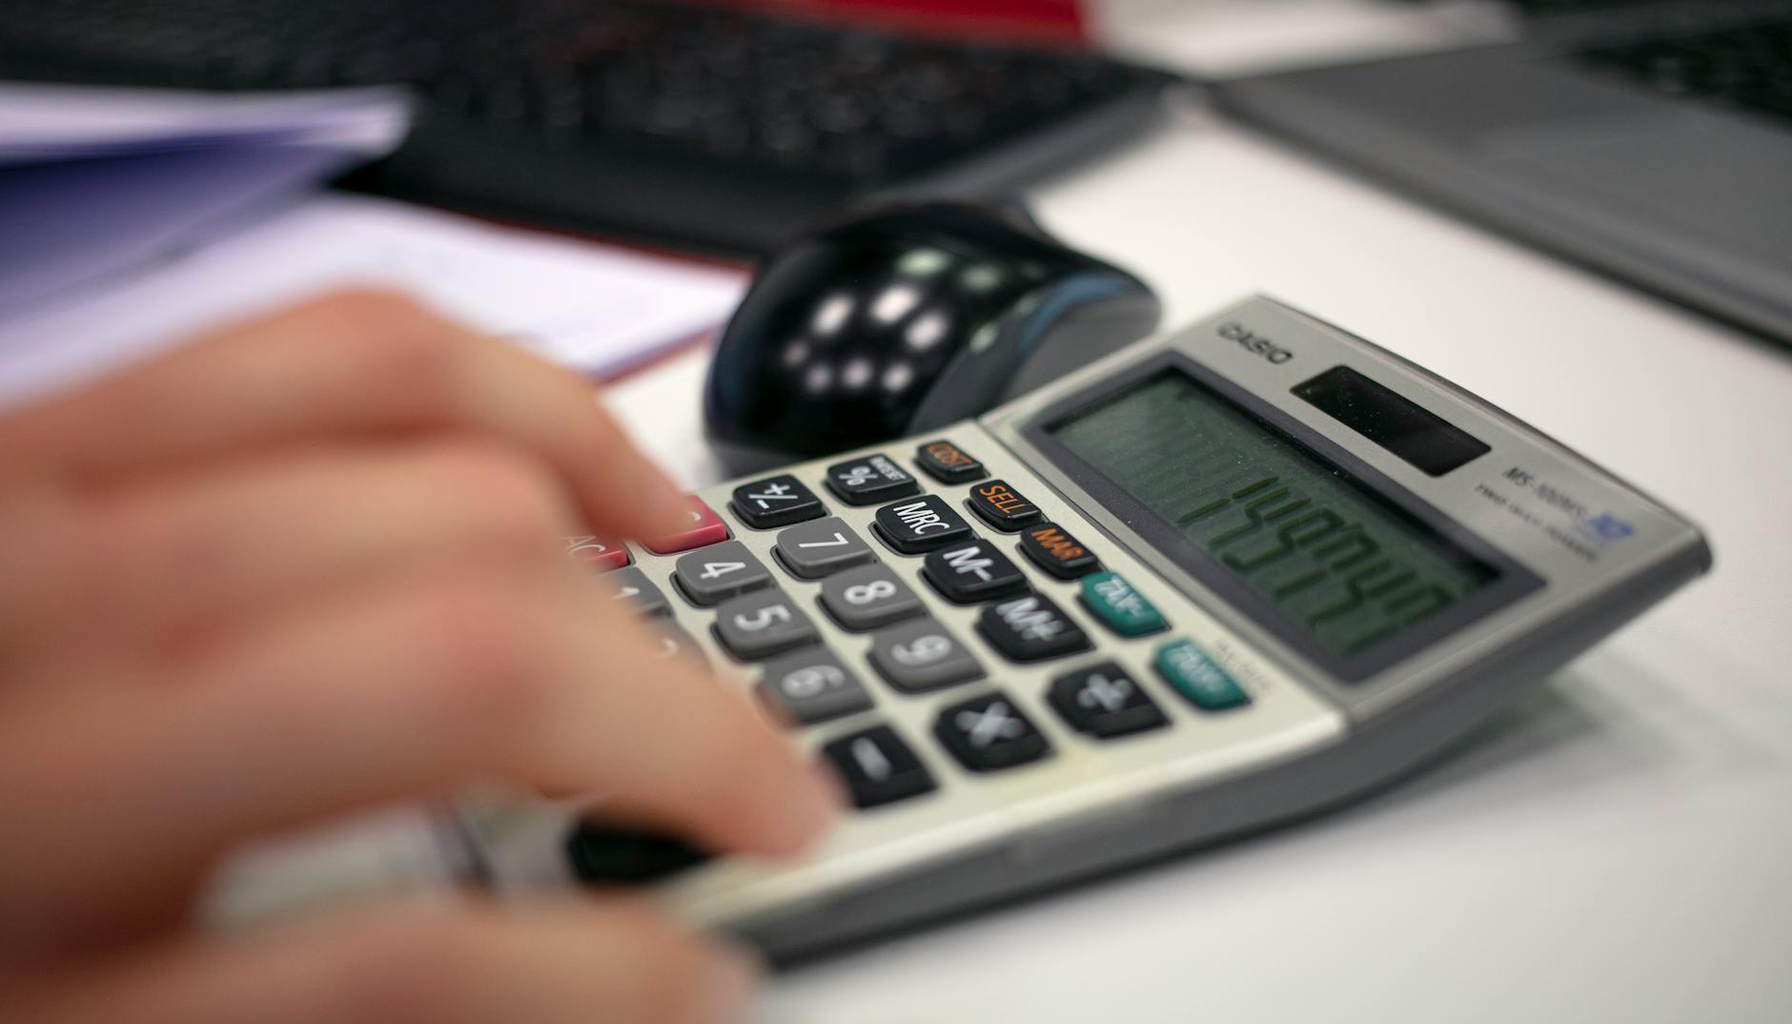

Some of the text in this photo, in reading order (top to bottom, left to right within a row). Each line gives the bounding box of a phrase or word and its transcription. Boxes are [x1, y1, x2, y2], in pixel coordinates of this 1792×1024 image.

[979, 485, 1026, 514] SELL
[893, 501, 950, 535] MRC
[798, 532, 849, 548] 7
[1030, 527, 1084, 561] MAR
[700, 562, 746, 580] 4
[942, 546, 994, 581] M-
[844, 580, 896, 604] 8
[734, 604, 792, 631] 5
[996, 596, 1064, 641] M+
[891, 635, 950, 665] 9
[781, 664, 845, 698] 6
